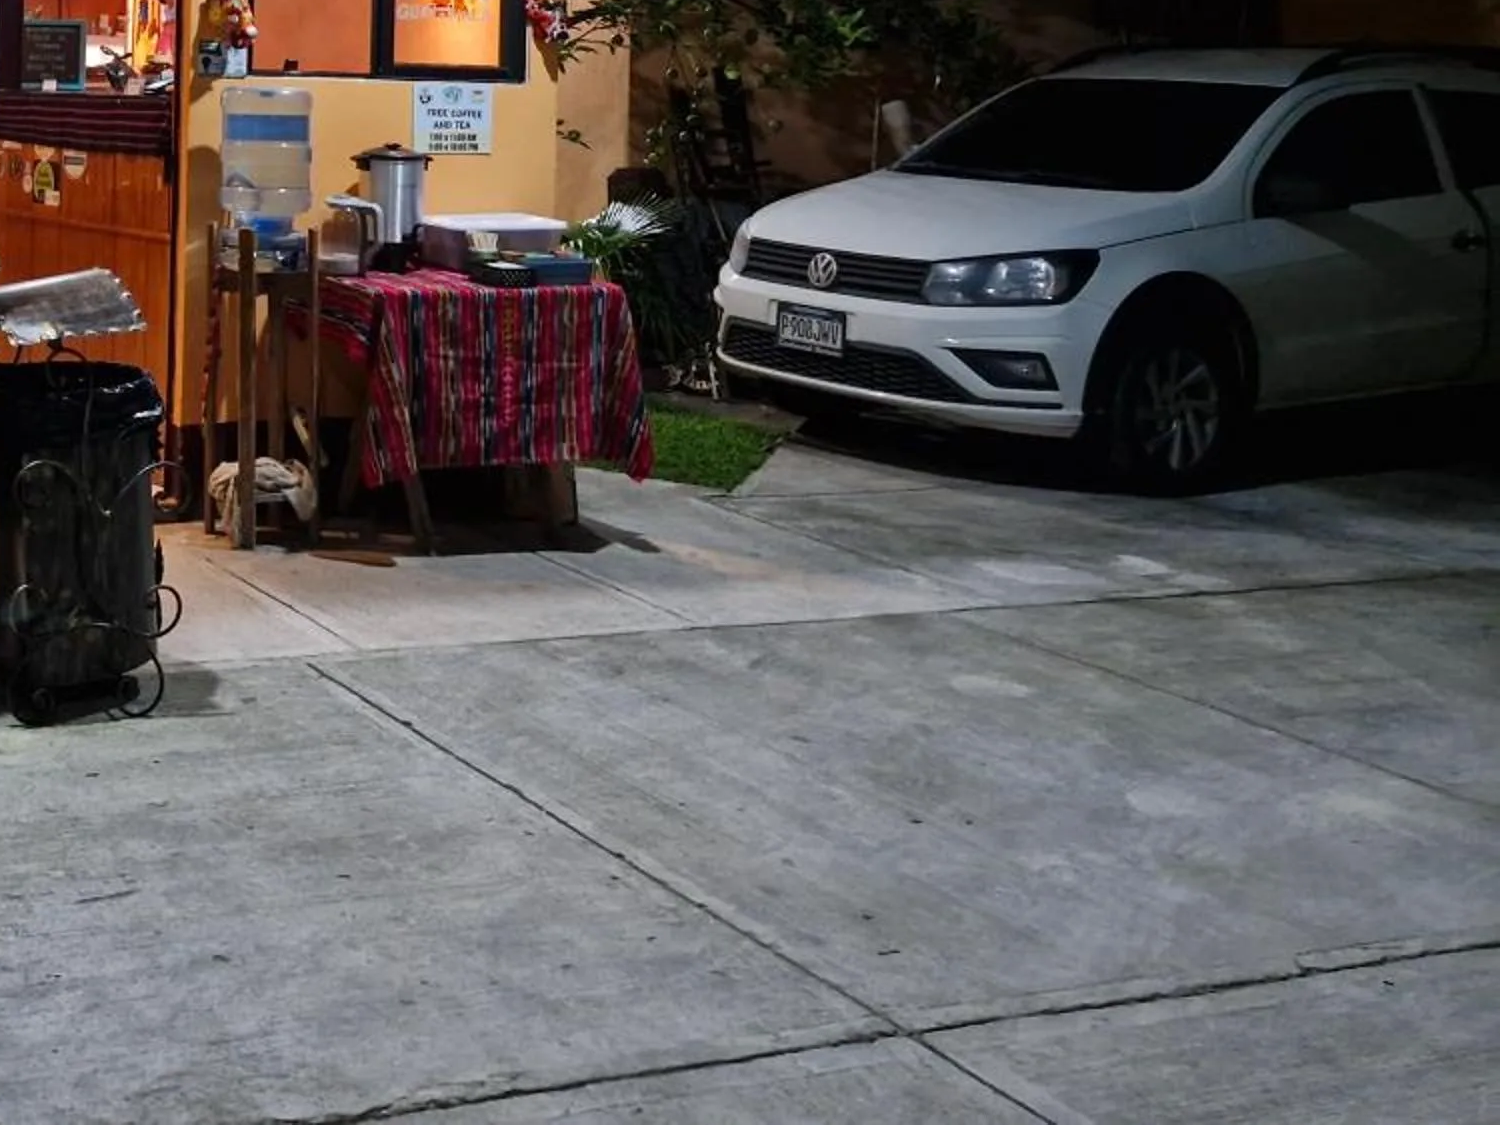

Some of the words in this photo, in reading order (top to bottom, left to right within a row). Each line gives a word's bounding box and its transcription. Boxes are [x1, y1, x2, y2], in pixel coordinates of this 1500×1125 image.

[427, 108, 448, 118] FREE
[451, 108, 482, 119] COFFEE
[433, 120, 453, 129] AND
[455, 120, 471, 129] TEA
